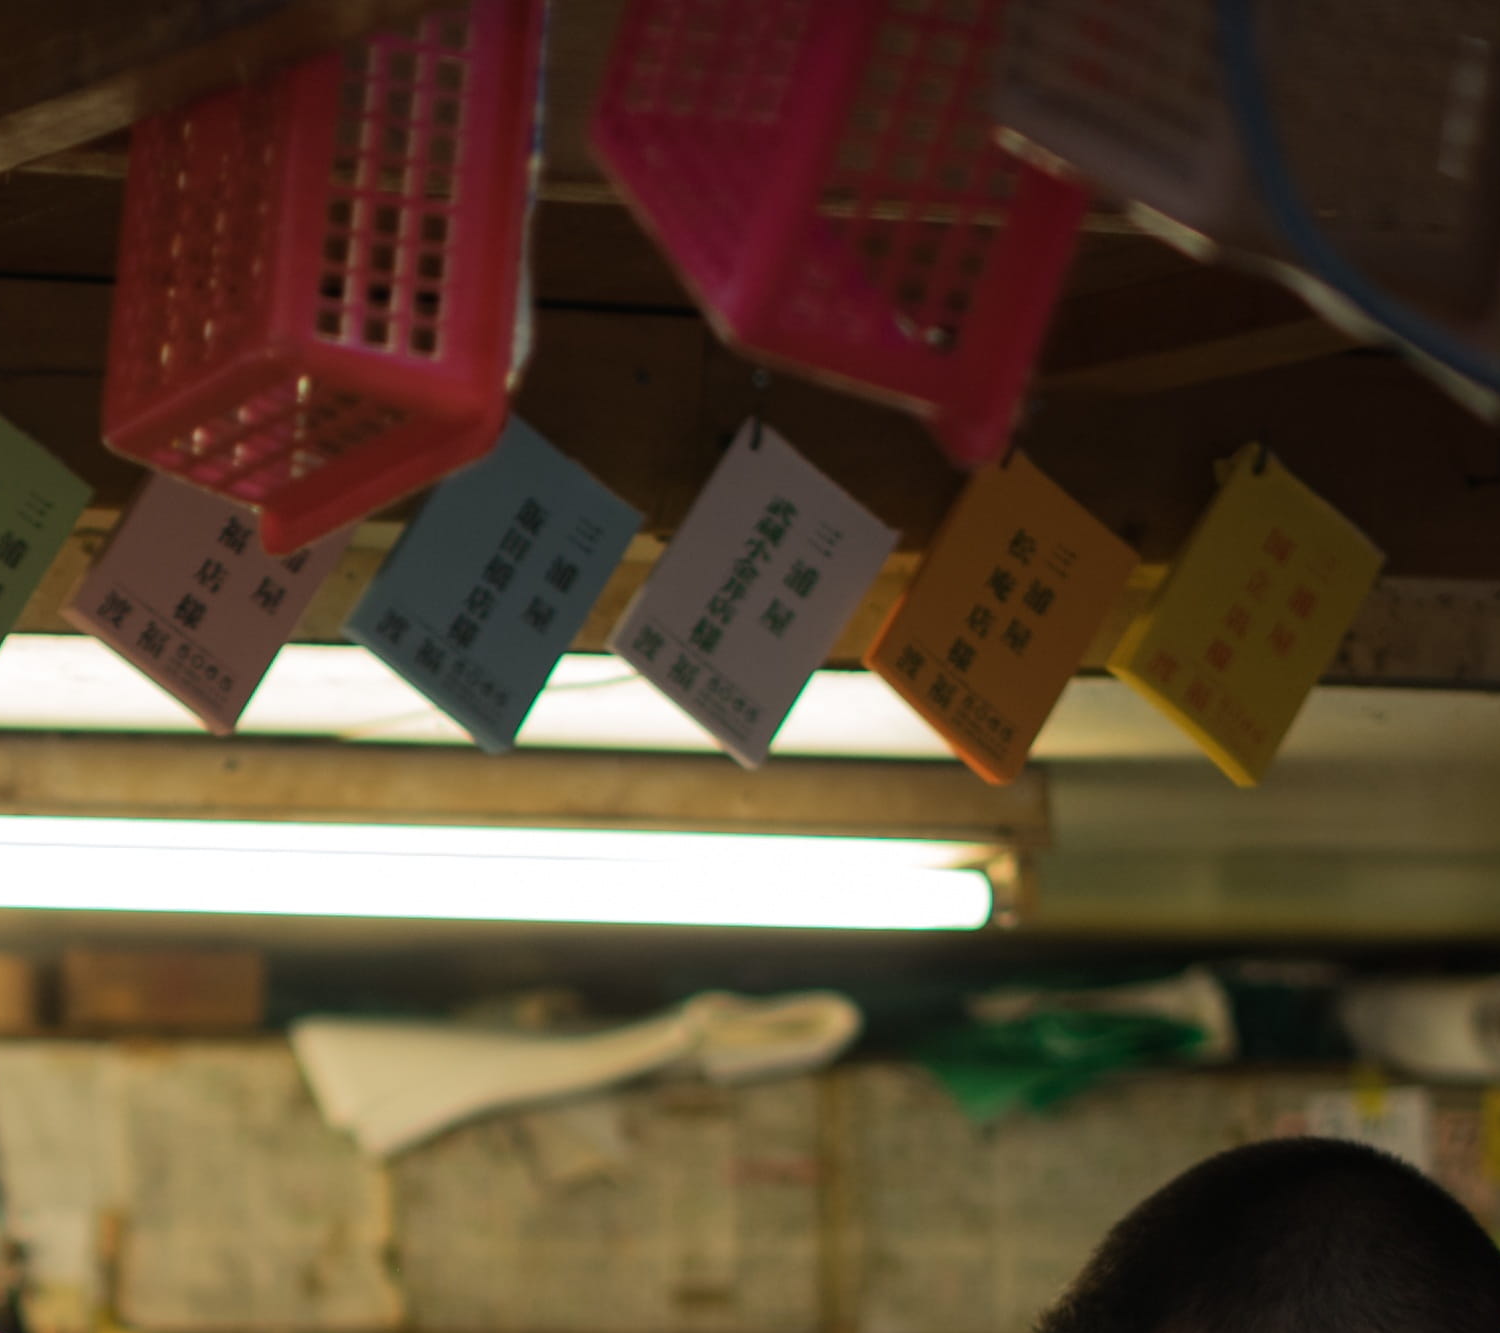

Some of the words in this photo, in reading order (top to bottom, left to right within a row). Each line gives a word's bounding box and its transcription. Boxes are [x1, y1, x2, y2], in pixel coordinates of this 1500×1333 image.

[447, 495, 550, 651] 飯田橋店様
[759, 520, 844, 639] 三浦屋
[1001, 540, 1078, 656] 三浦屋
